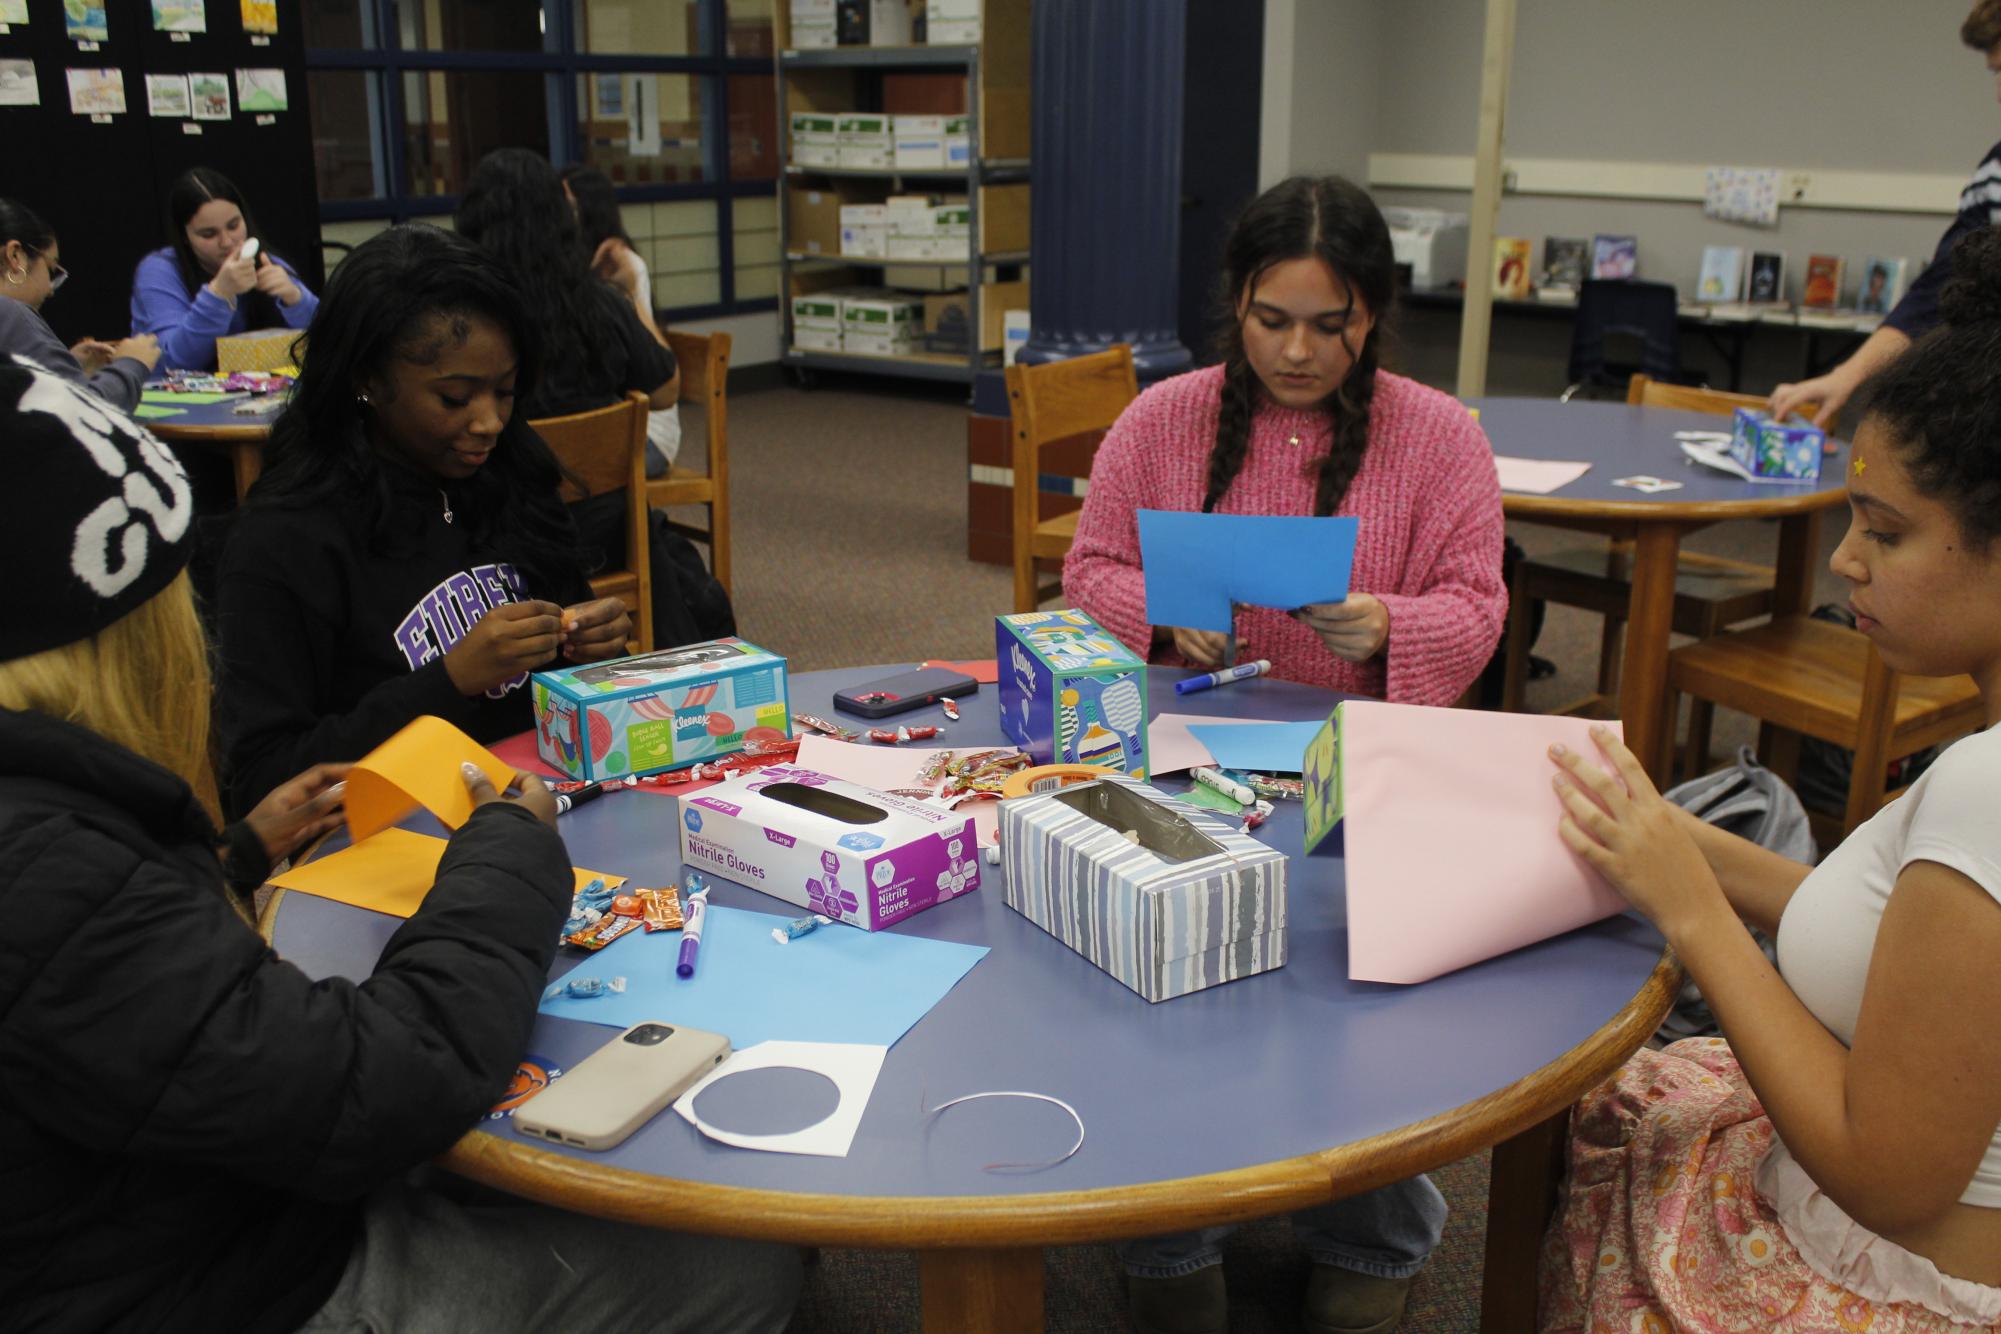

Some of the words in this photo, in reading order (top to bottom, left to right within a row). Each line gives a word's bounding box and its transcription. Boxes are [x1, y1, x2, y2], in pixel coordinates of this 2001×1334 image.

[673, 714, 712, 734] Kleenex
[768, 832, 792, 847] X-Large
[943, 826, 962, 837] X-Large
[688, 840, 725, 864] Nitrile
[726, 854, 766, 880] Gloves
[825, 852, 836, 865] 100
[878, 887, 908, 906] Nitrile
[879, 898, 910, 917] Gloves
